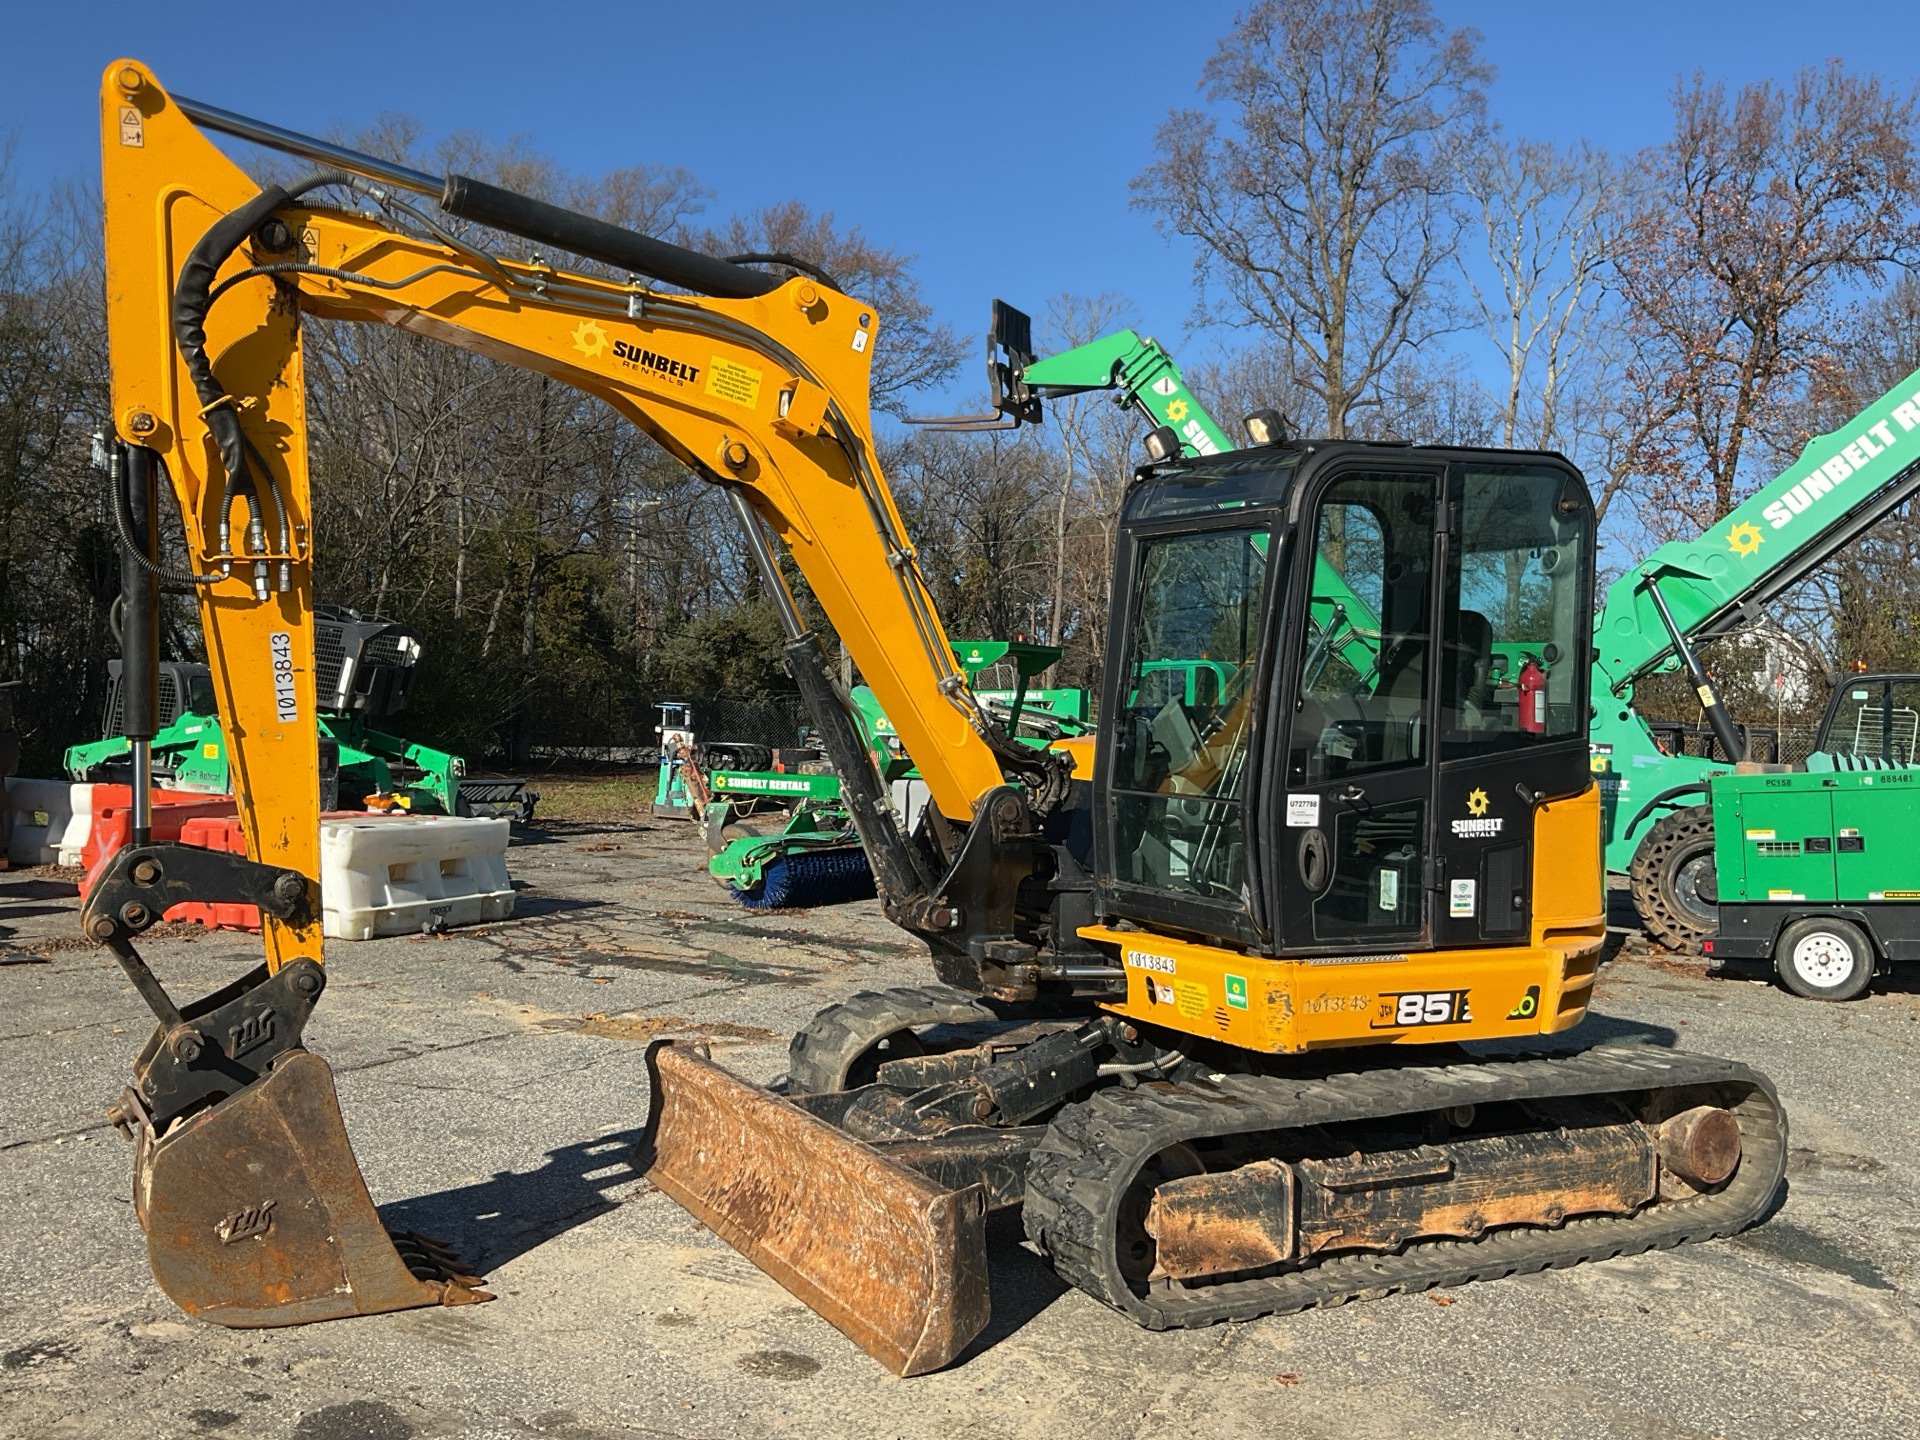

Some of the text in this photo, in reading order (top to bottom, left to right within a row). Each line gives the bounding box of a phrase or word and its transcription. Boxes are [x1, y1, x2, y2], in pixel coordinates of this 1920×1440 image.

[612, 340, 700, 383] SUNBELT
[622, 360, 684, 387] RENTALS
[1182, 419, 1220, 457] SUN
[1761, 390, 1920, 530] SUNBELT R
[271, 633, 297, 720] 1013843
[727, 777, 811, 791] SUNBELT RENTALS
[1598, 780, 1631, 791] BELT
[1765, 779, 1792, 787] PC158
[1880, 774, 1914, 784] 888401
[1451, 818, 1504, 833] SUNBELT
[1458, 831, 1496, 839] RENTALS
[1129, 952, 1176, 973] 1013843
[1397, 993, 1451, 1025] 85
